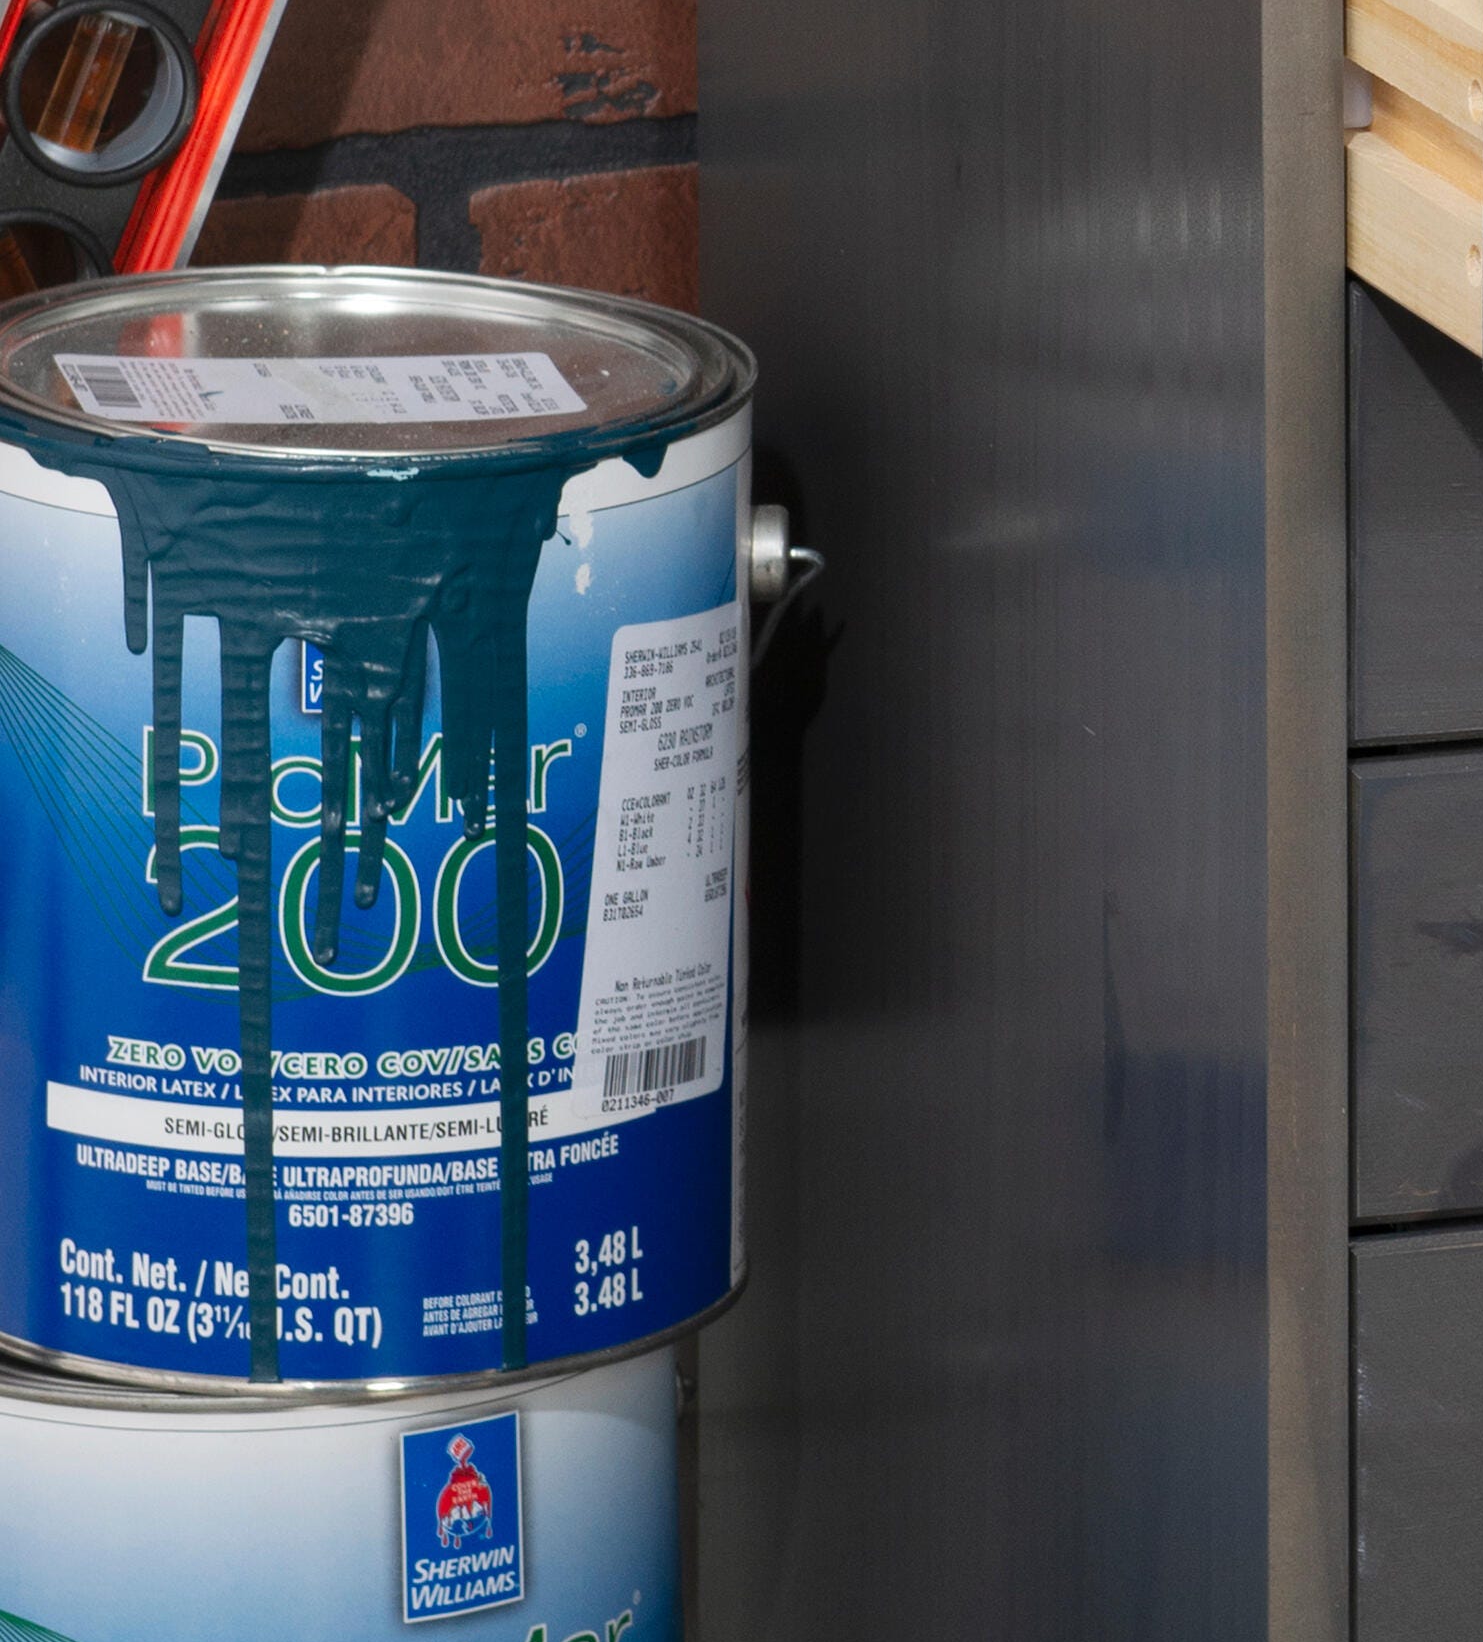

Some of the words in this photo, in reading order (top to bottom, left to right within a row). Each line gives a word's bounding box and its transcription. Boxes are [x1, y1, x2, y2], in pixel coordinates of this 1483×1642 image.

[143, 821, 564, 997] 200
[106, 1034, 187, 1072] ZERO
[191, 1046, 368, 1079] VO/CERO
[377, 1036, 545, 1078] COV/SAS
[79, 1064, 159, 1093] INTERIOR
[161, 1077, 217, 1100] LATEX
[297, 1086, 348, 1103] PARA
[352, 1080, 463, 1103] INTERIORES
[76, 1143, 171, 1179] ULTRADEEP
[282, 1157, 498, 1189] ULTRAPROFUNDA/BASE
[560, 1132, 620, 1168] FONCÉE
[288, 1203, 414, 1227] 6501-87396
[59, 1237, 124, 1284] Cont.
[131, 1250, 187, 1292] Net.
[213, 1260, 250, 1298] Ne
[275, 1263, 350, 1300] Cont.
[574, 1229, 626, 1277] 3,48
[631, 1225, 644, 1259] L
[60, 1281, 104, 1323] 118
[109, 1290, 140, 1329] FL
[146, 1296, 181, 1335] OZ
[334, 1306, 383, 1349] QT)
[574, 1272, 626, 1316] 3.48
[631, 1267, 644, 1302] L
[412, 1545, 515, 1585] SHERWIN
[411, 1571, 517, 1610] WILLIAMS
